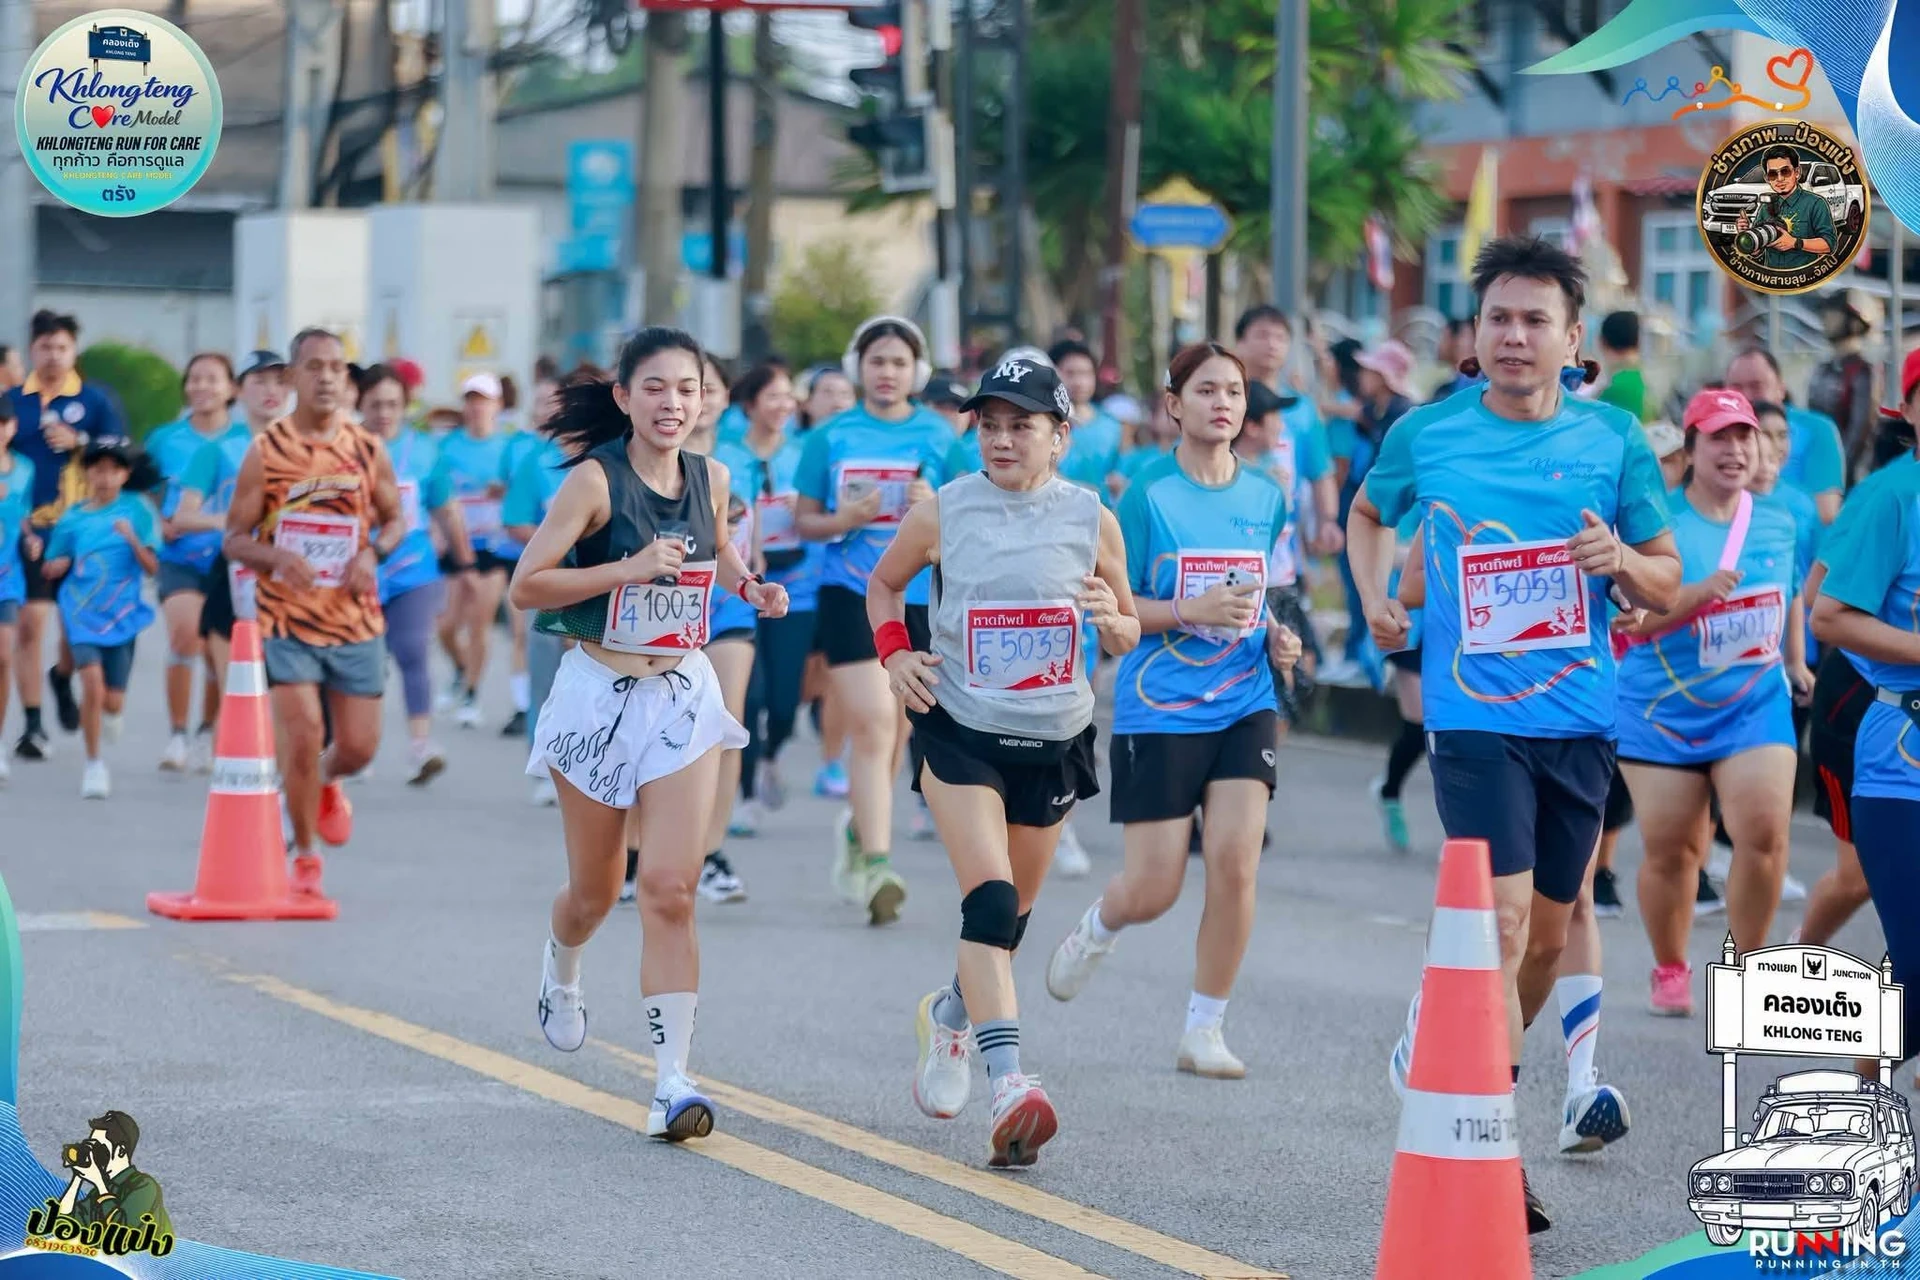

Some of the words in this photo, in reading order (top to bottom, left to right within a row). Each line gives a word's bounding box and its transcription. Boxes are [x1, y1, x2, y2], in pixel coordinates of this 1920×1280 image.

[992, 361, 1033, 383] NY
[1469, 577, 1488, 598] M
[1494, 567, 1566, 607] 5059
[620, 603, 638, 632] 4
[623, 585, 640, 609] F
[644, 588, 702, 623] 1003
[1471, 605, 1493, 627] 5
[976, 630, 996, 655] F
[1000, 627, 1071, 662] 5039
[978, 655, 992, 676] 6
